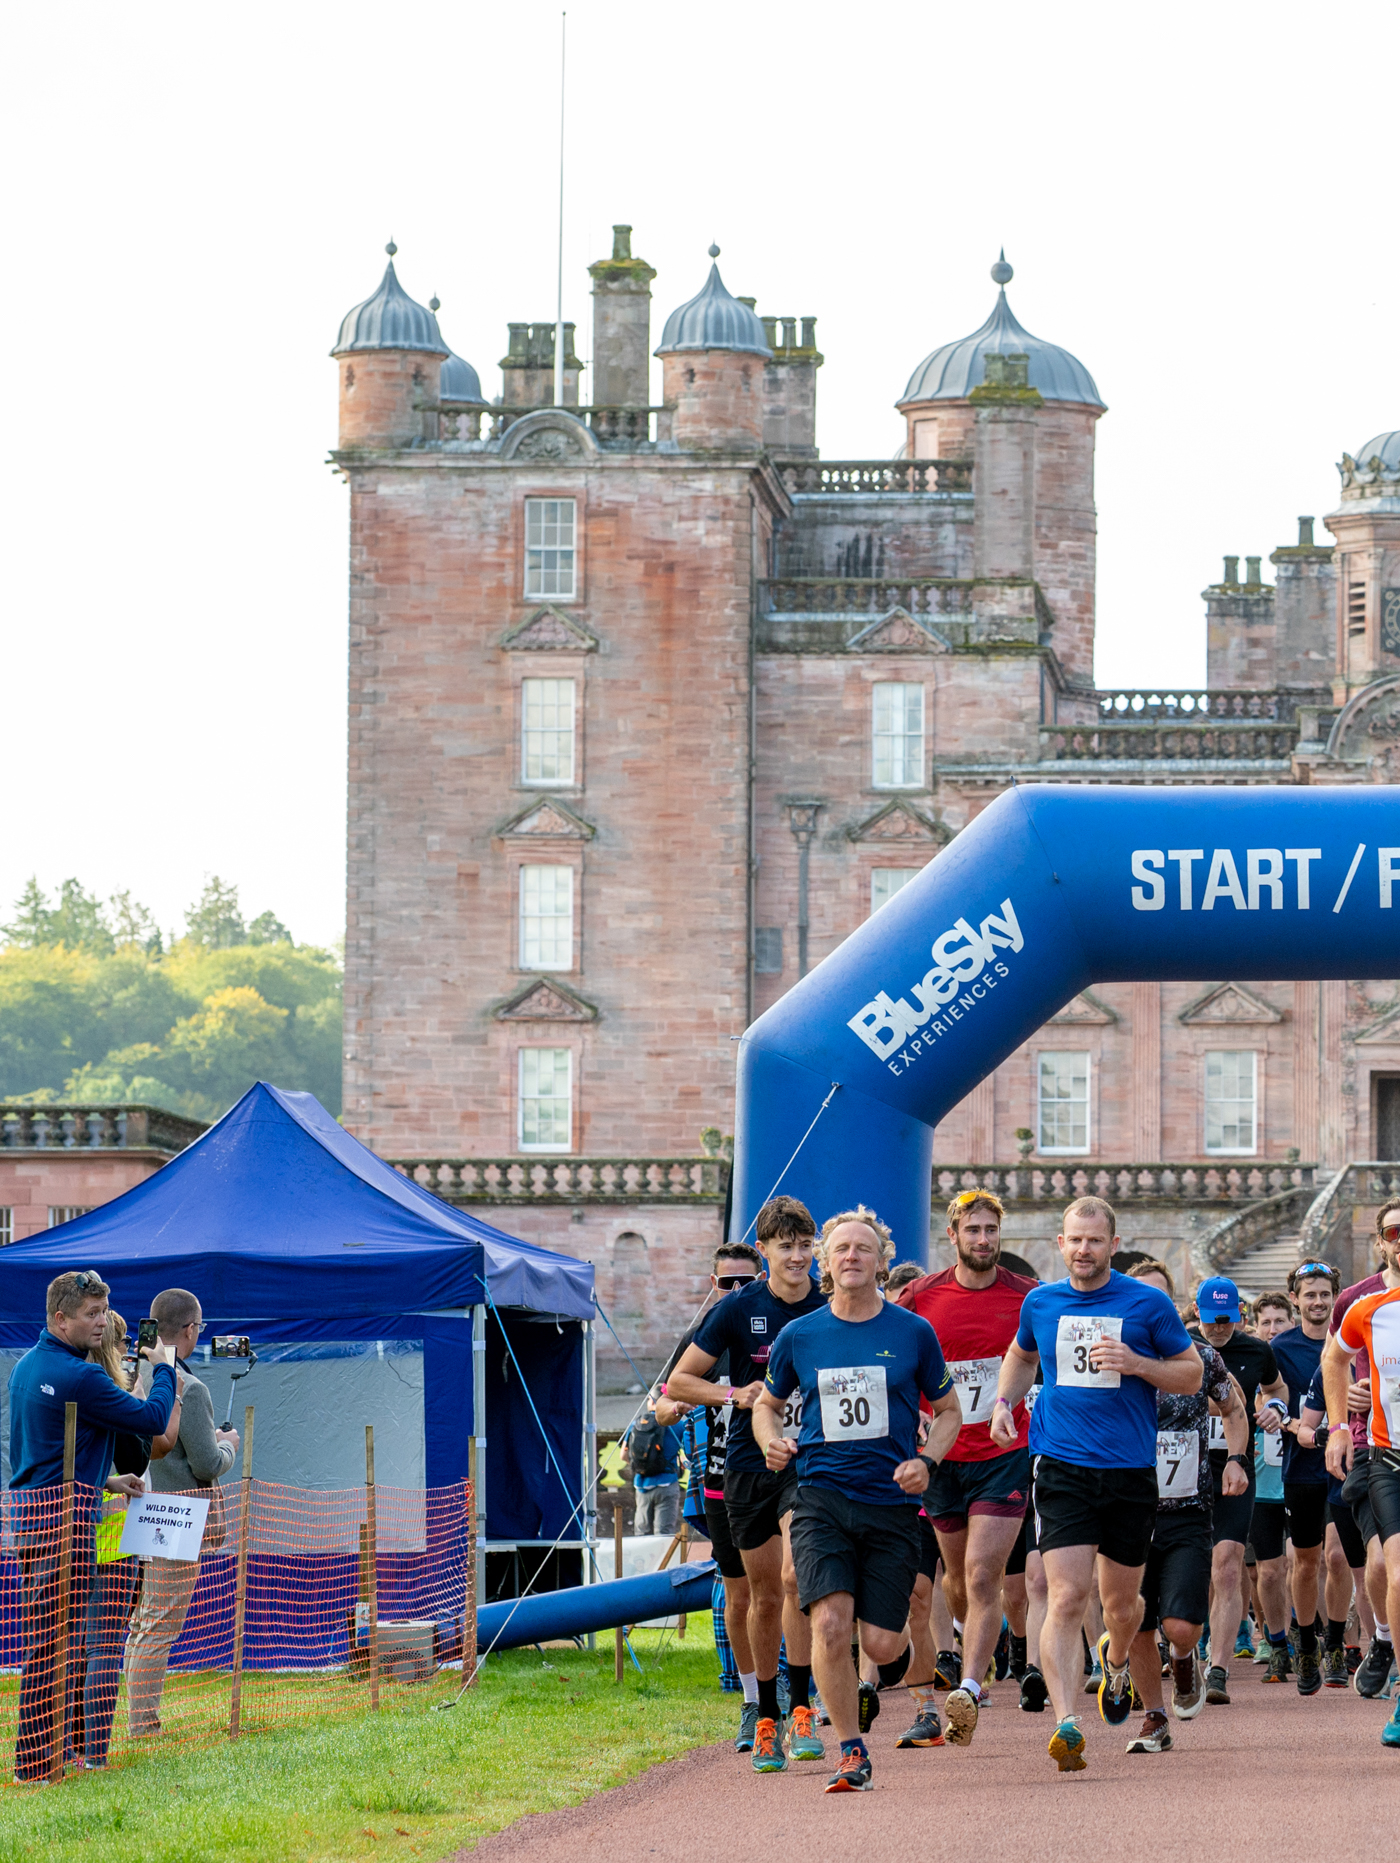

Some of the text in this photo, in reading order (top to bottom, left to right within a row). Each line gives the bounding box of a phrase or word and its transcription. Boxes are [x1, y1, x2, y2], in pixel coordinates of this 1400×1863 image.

[1131, 848, 1322, 911] START
[1332, 843, 1366, 914] /
[847, 897, 1025, 1062] BlueSky
[887, 962, 1010, 1077] EXPERIENCES
[1212, 1290, 1229, 1300] fuse
[839, 1397, 870, 1427] 30
[968, 1385, 982, 1412] 7
[1165, 1460, 1181, 1486] 7
[138, 1515, 193, 1529] SMASHING IT
[146, 1503, 192, 1516] WILD BOYZ
